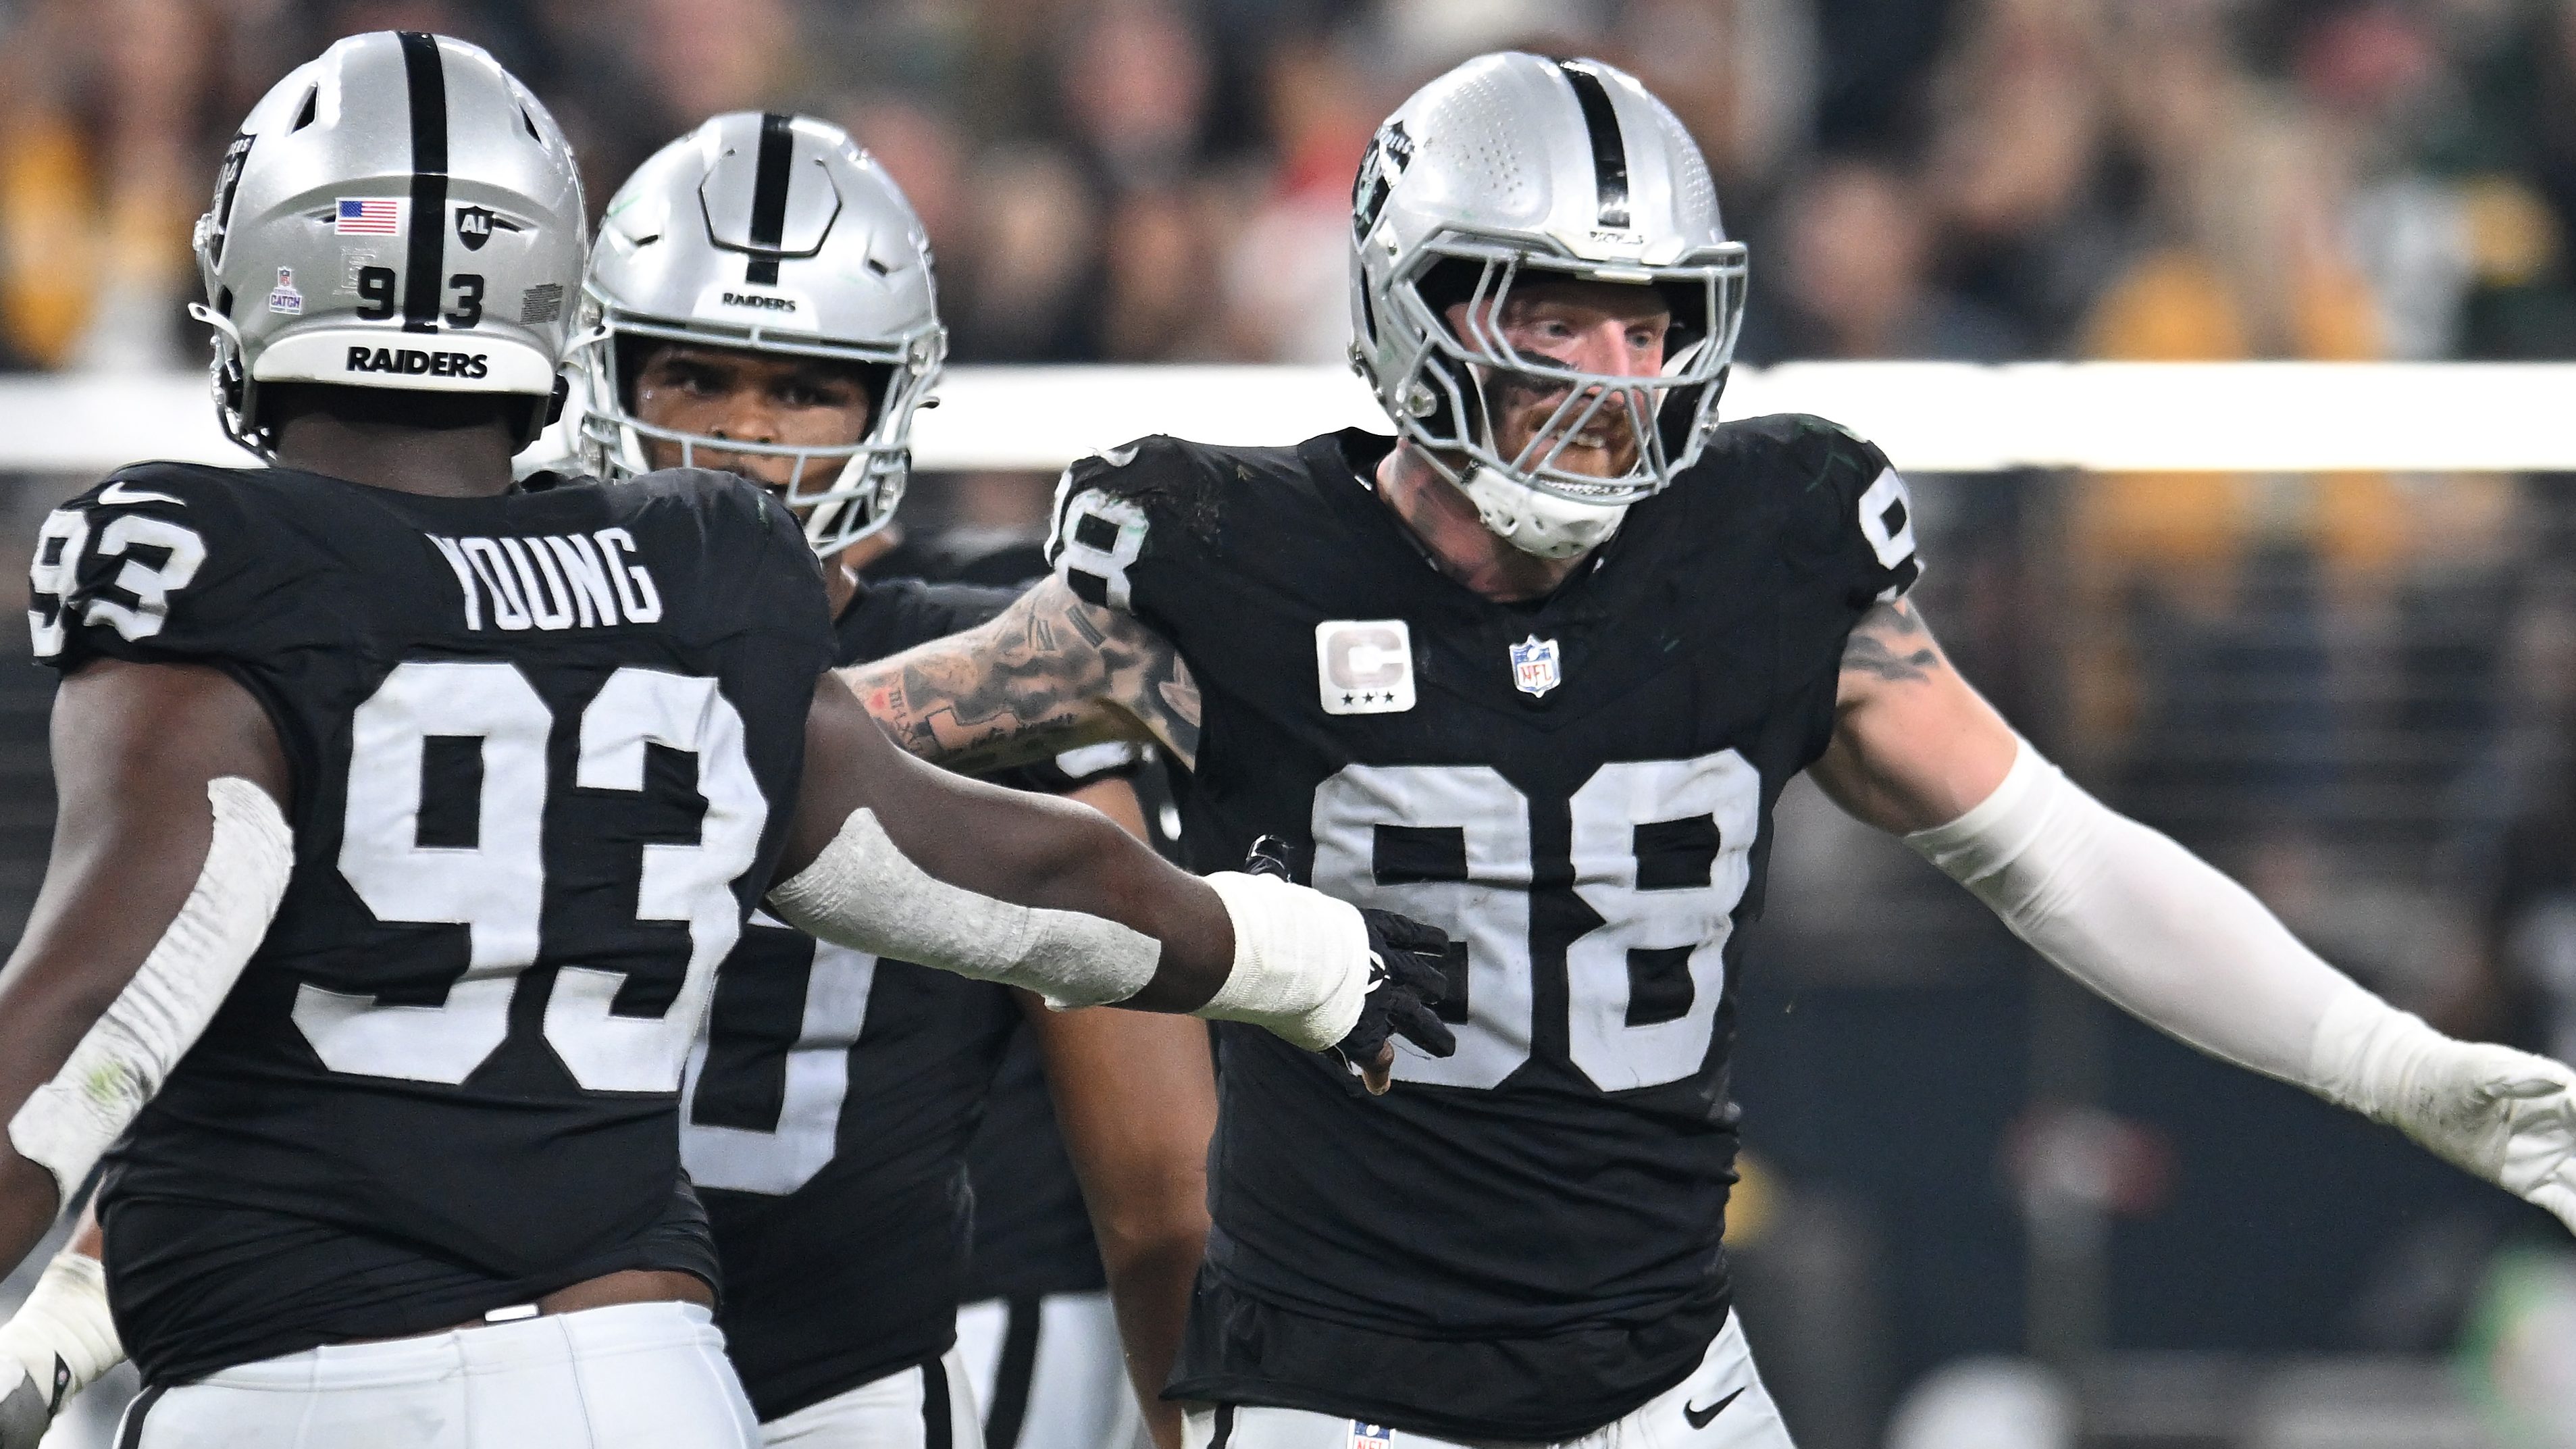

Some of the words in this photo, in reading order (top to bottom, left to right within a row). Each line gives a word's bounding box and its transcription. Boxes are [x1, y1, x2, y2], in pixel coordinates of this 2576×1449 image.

[461, 213, 489, 234] AL
[271, 295, 300, 308] CATCH
[723, 292, 796, 312] RAIDERS
[347, 346, 488, 380] RAIDERS
[28, 509, 207, 657] 93
[426, 527, 663, 632] YOUNG
[1326, 628, 1404, 690] C
[1520, 664, 1552, 686] NFL
[291, 661, 770, 1093] 93
[1312, 747, 1761, 1093] 98
